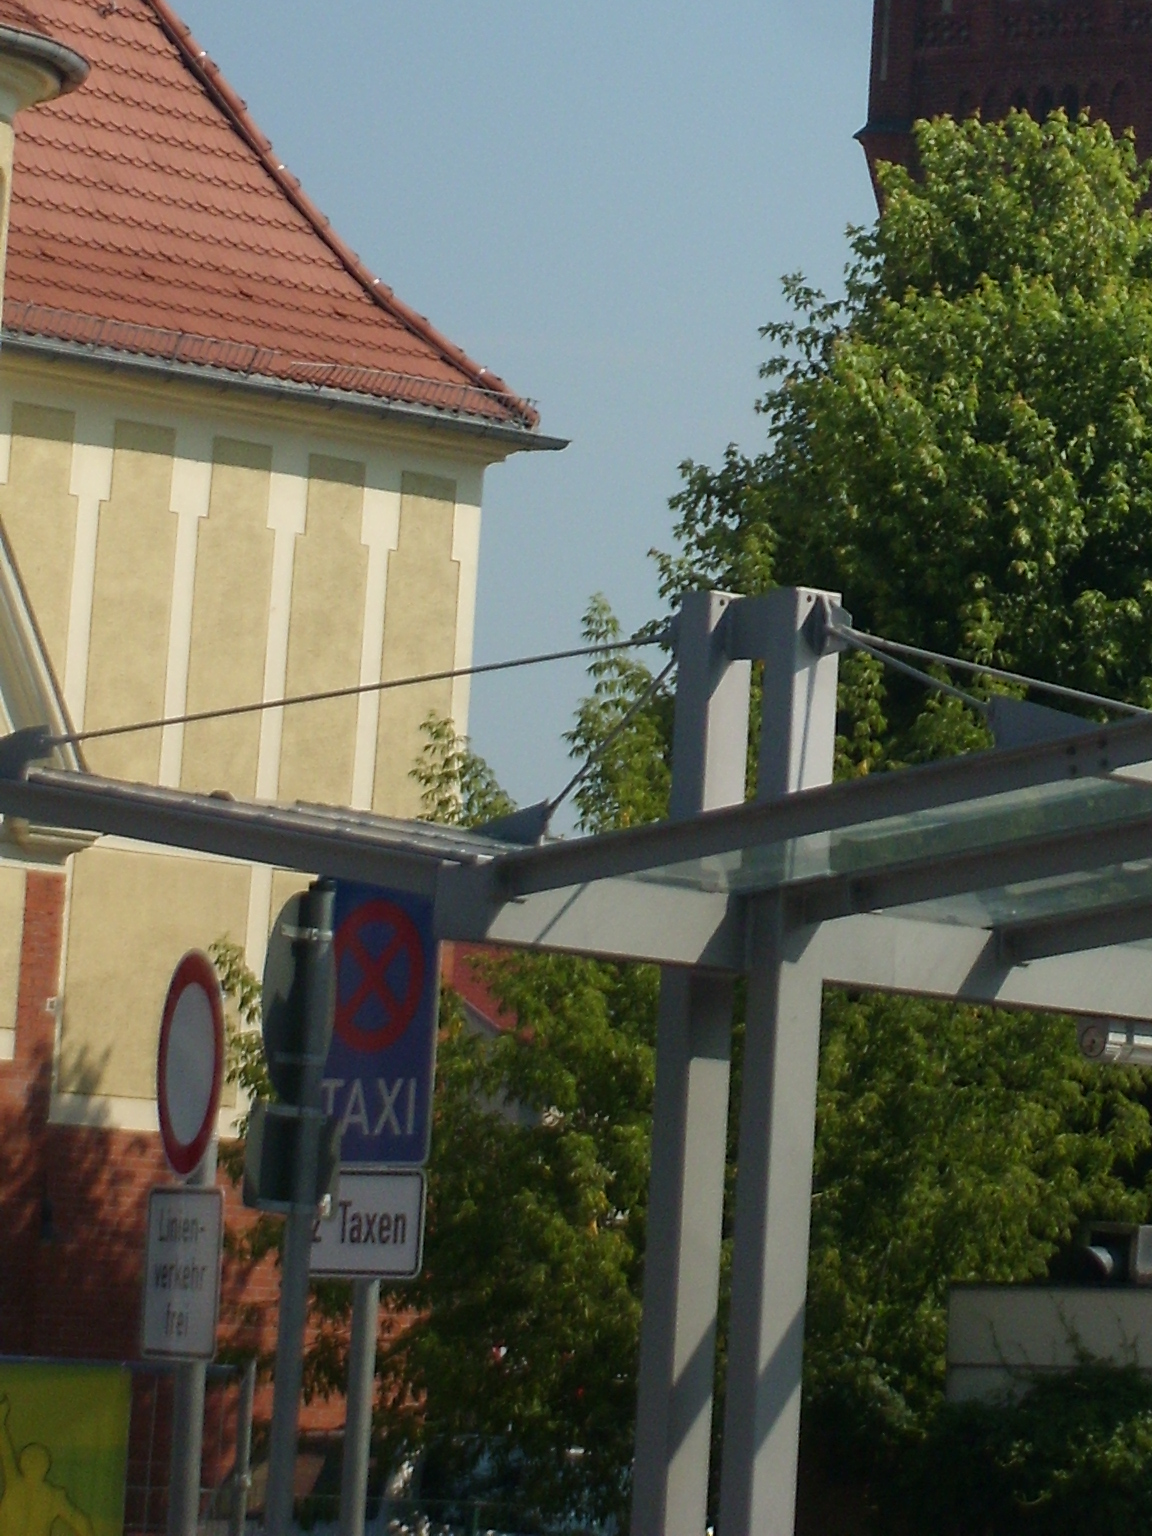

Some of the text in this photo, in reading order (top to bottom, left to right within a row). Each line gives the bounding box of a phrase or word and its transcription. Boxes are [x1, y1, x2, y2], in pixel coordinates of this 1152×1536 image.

[320, 1076, 417, 1136] TAXI
[157, 1208, 206, 1242] Linien-
[338, 1199, 407, 1245] Taxen
[154, 1254, 208, 1290] verkehr
[164, 1301, 190, 1337] frei
